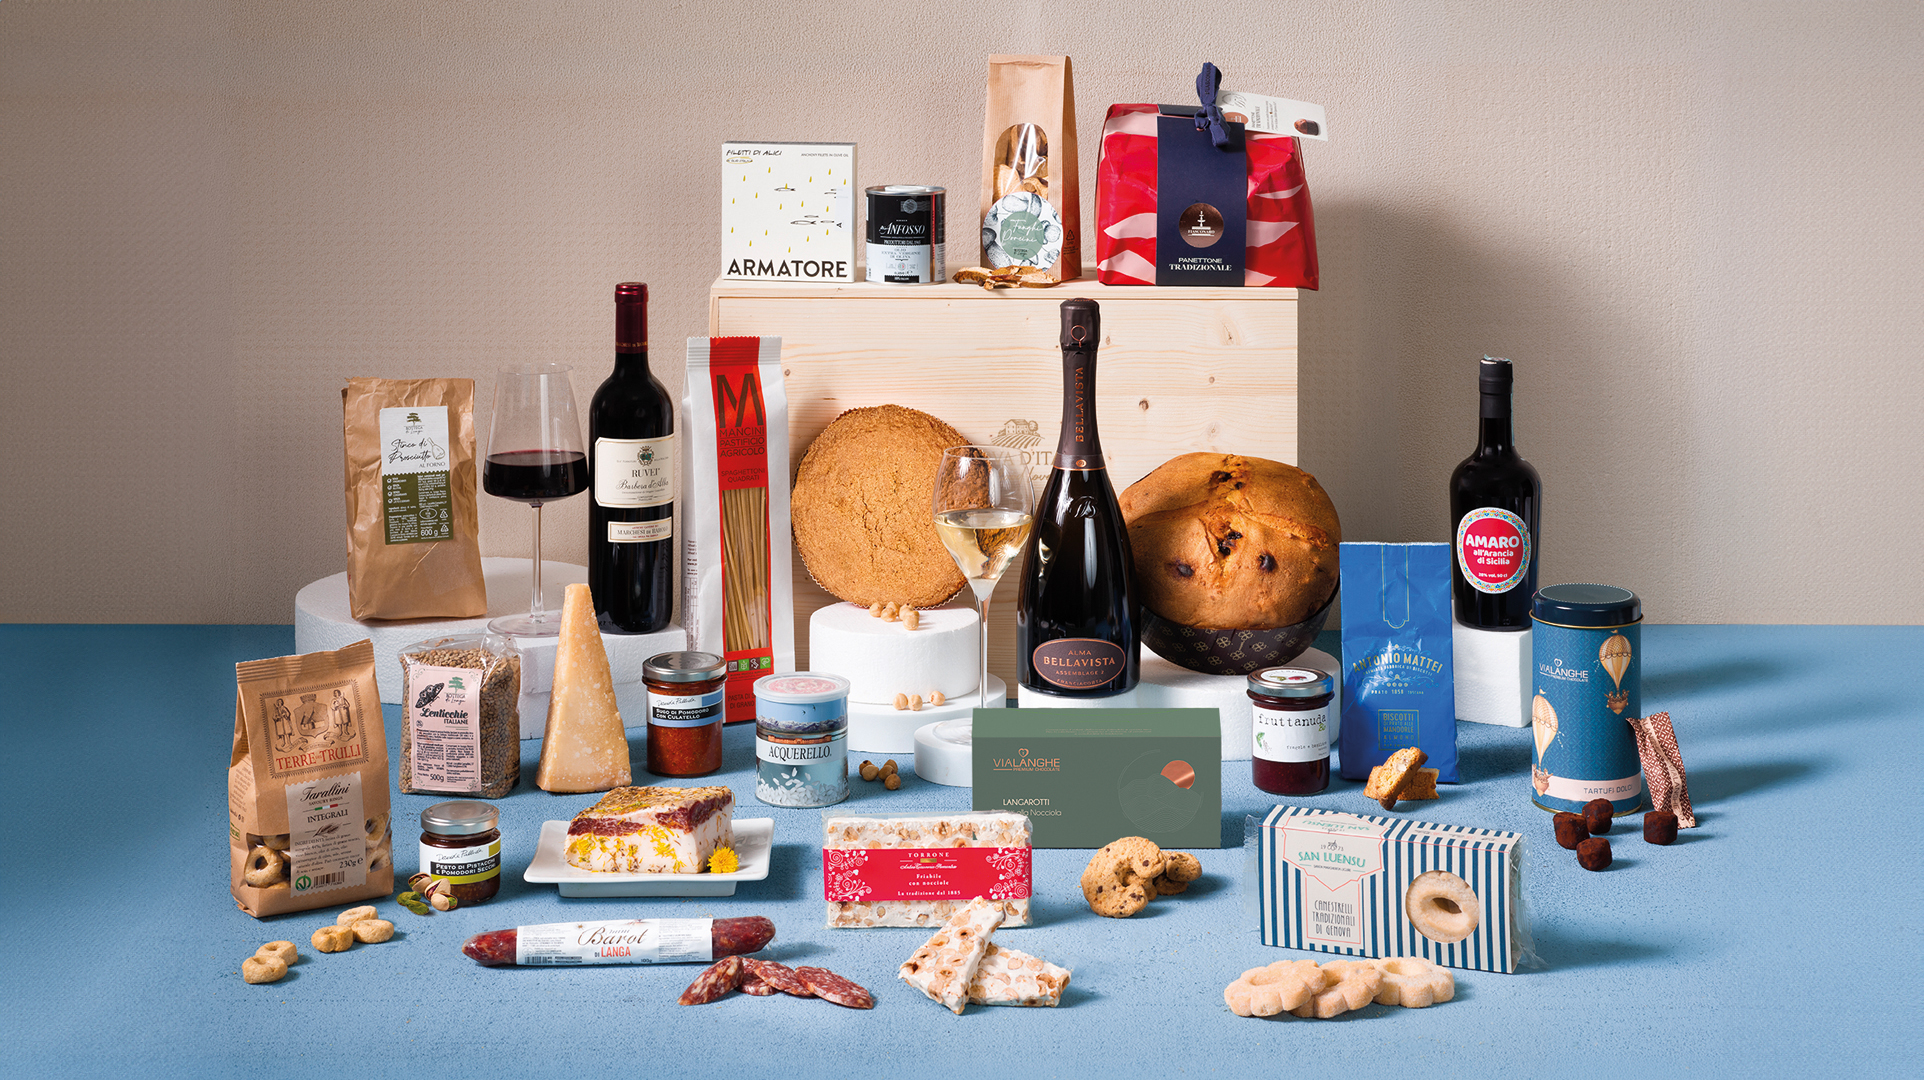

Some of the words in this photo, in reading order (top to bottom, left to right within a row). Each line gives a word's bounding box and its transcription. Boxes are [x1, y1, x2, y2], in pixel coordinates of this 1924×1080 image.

[727, 258, 848, 277] ARMATORE
[716, 373, 764, 428] M
[1075, 367, 1084, 442] BELLAVISTA
[720, 427, 764, 437] MANCINI
[391, 439, 416, 452] Stinco
[419, 438, 427, 447] di
[720, 437, 765, 447] PASTIFICIO
[388, 450, 431, 464] Prosciutto
[720, 447, 765, 457] AGRICOLO
[721, 468, 765, 476] SPAGHETTONI
[727, 474, 760, 483] QUADRATI
[616, 479, 647, 490] Barbera
[1466, 534, 1519, 548] AMARO
[1473, 549, 1514, 557] all'Arancia
[1043, 656, 1115, 667] BELLAVISTA
[1353, 653, 1400, 673] ANTONIO
[1404, 653, 1443, 673] MATTEI
[1539, 663, 1588, 678] VIALANGHE
[420, 707, 468, 718] Lenticchie
[1383, 713, 1413, 721] BISCOTTI
[1258, 713, 1326, 727] fruttanuda
[276, 752, 316, 770] TERRE
[319, 744, 361, 762] TRULLI
[993, 758, 1060, 767] VIALANGHE
[430, 773, 445, 783] 500g
[300, 781, 351, 802] Tarallini
[1583, 787, 1615, 795] TARTUFI
[1669, 764, 1681, 810] VIALANGHE
[1003, 798, 1050, 806] LANGAROTTI
[307, 809, 348, 823] INTEGRALI
[340, 860, 356, 868] 230g
[1298, 851, 1320, 861] SAN
[1323, 852, 1366, 868] LUENSU
[1315, 900, 1352, 914] CANESTRELLI
[1312, 911, 1355, 926] TRADIZIONALI
[1316, 924, 1322, 934] DI
[1326, 925, 1350, 937] GENOVA
[601, 946, 631, 957] LANGA
